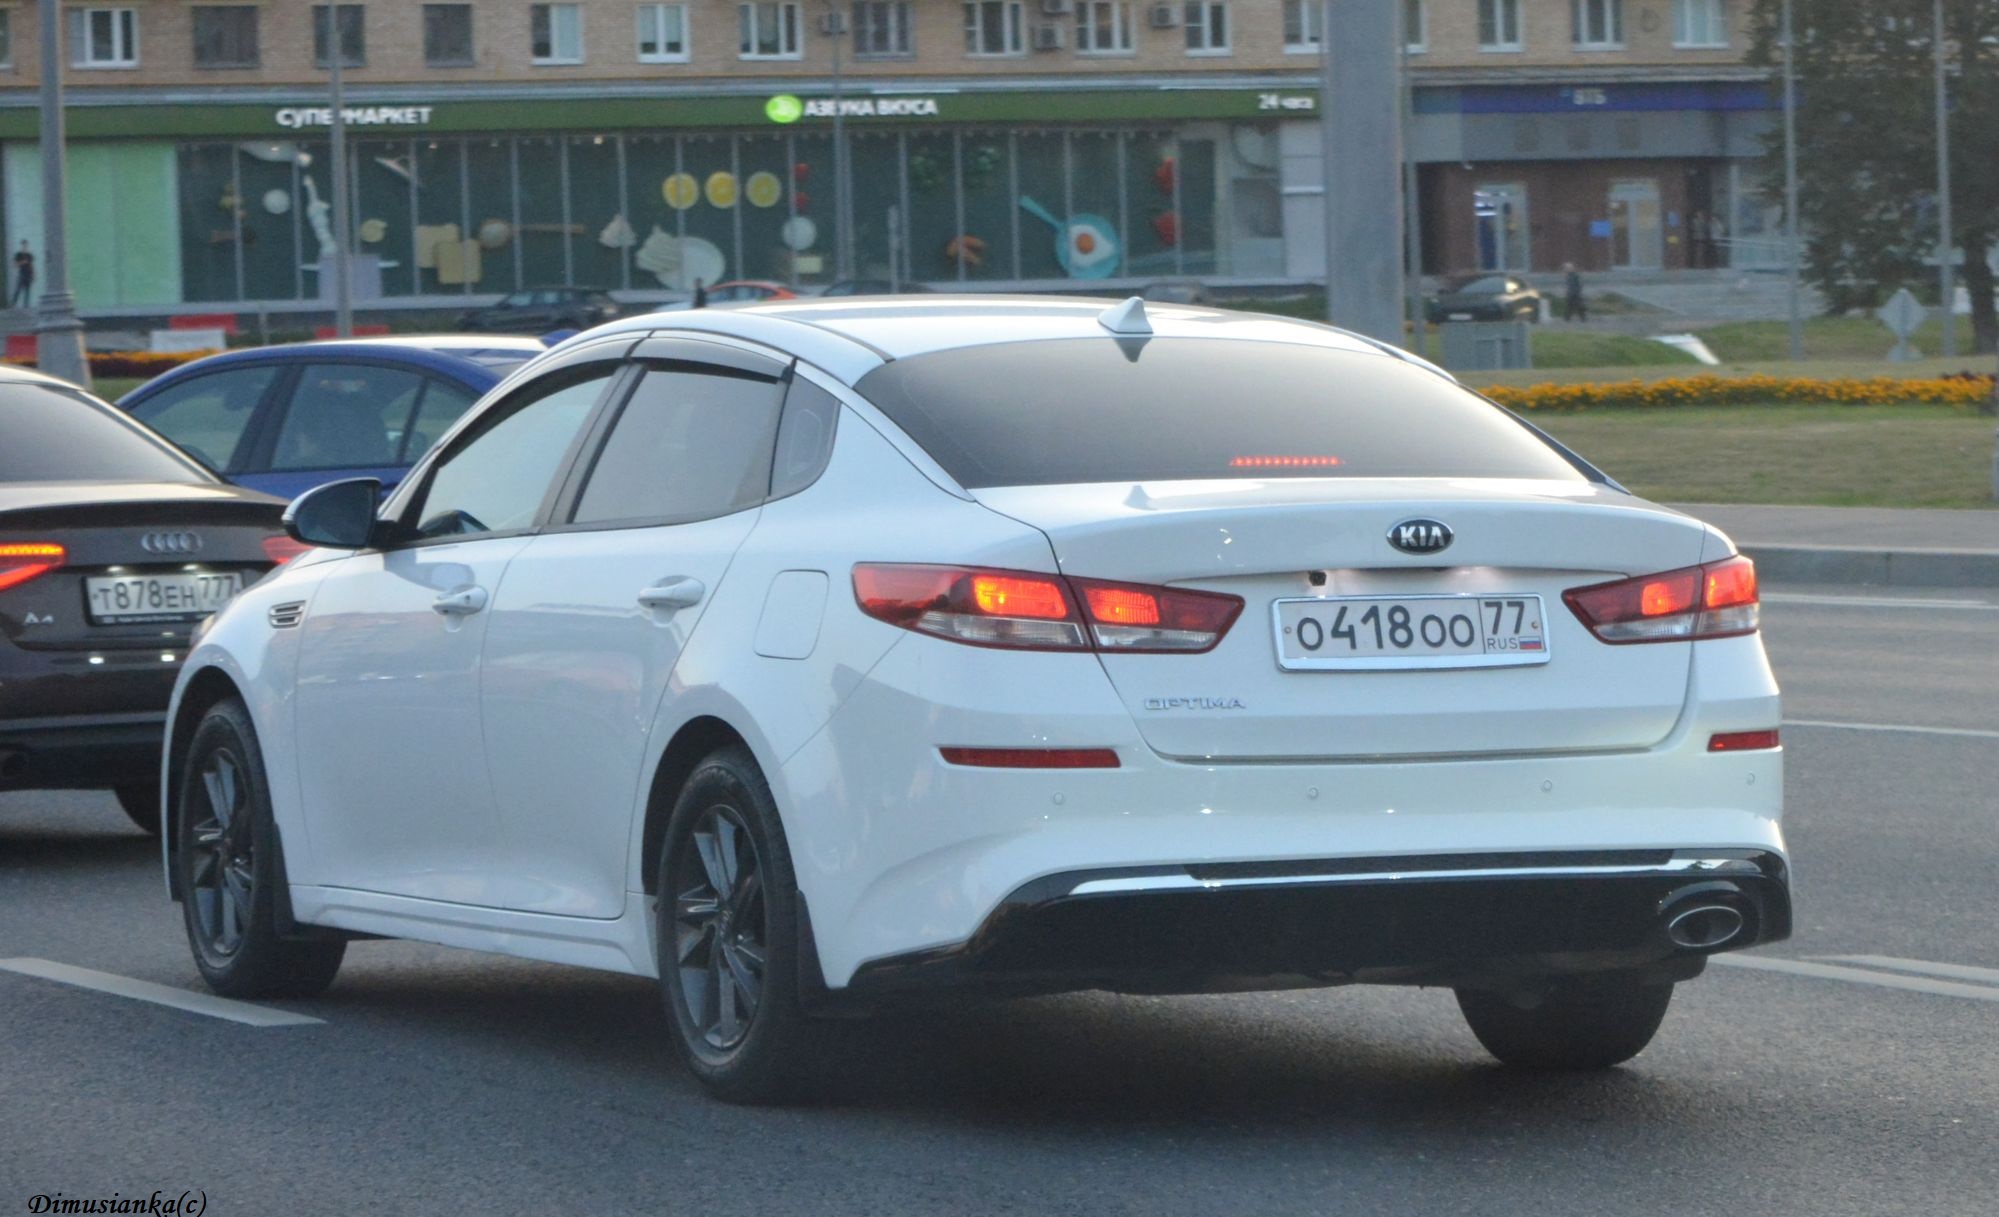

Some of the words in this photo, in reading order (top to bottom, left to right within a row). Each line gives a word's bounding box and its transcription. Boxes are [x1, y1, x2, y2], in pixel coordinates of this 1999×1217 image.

[877, 98, 939, 116] ВКУСА
[1258, 93, 1278, 109] 24
[1399, 526, 1445, 546] KIA
[198, 575, 235, 599] 777
[1485, 601, 1526, 636] 77
[1487, 637, 1517, 650] RUS
[1144, 696, 1247, 711] OPTIMA
